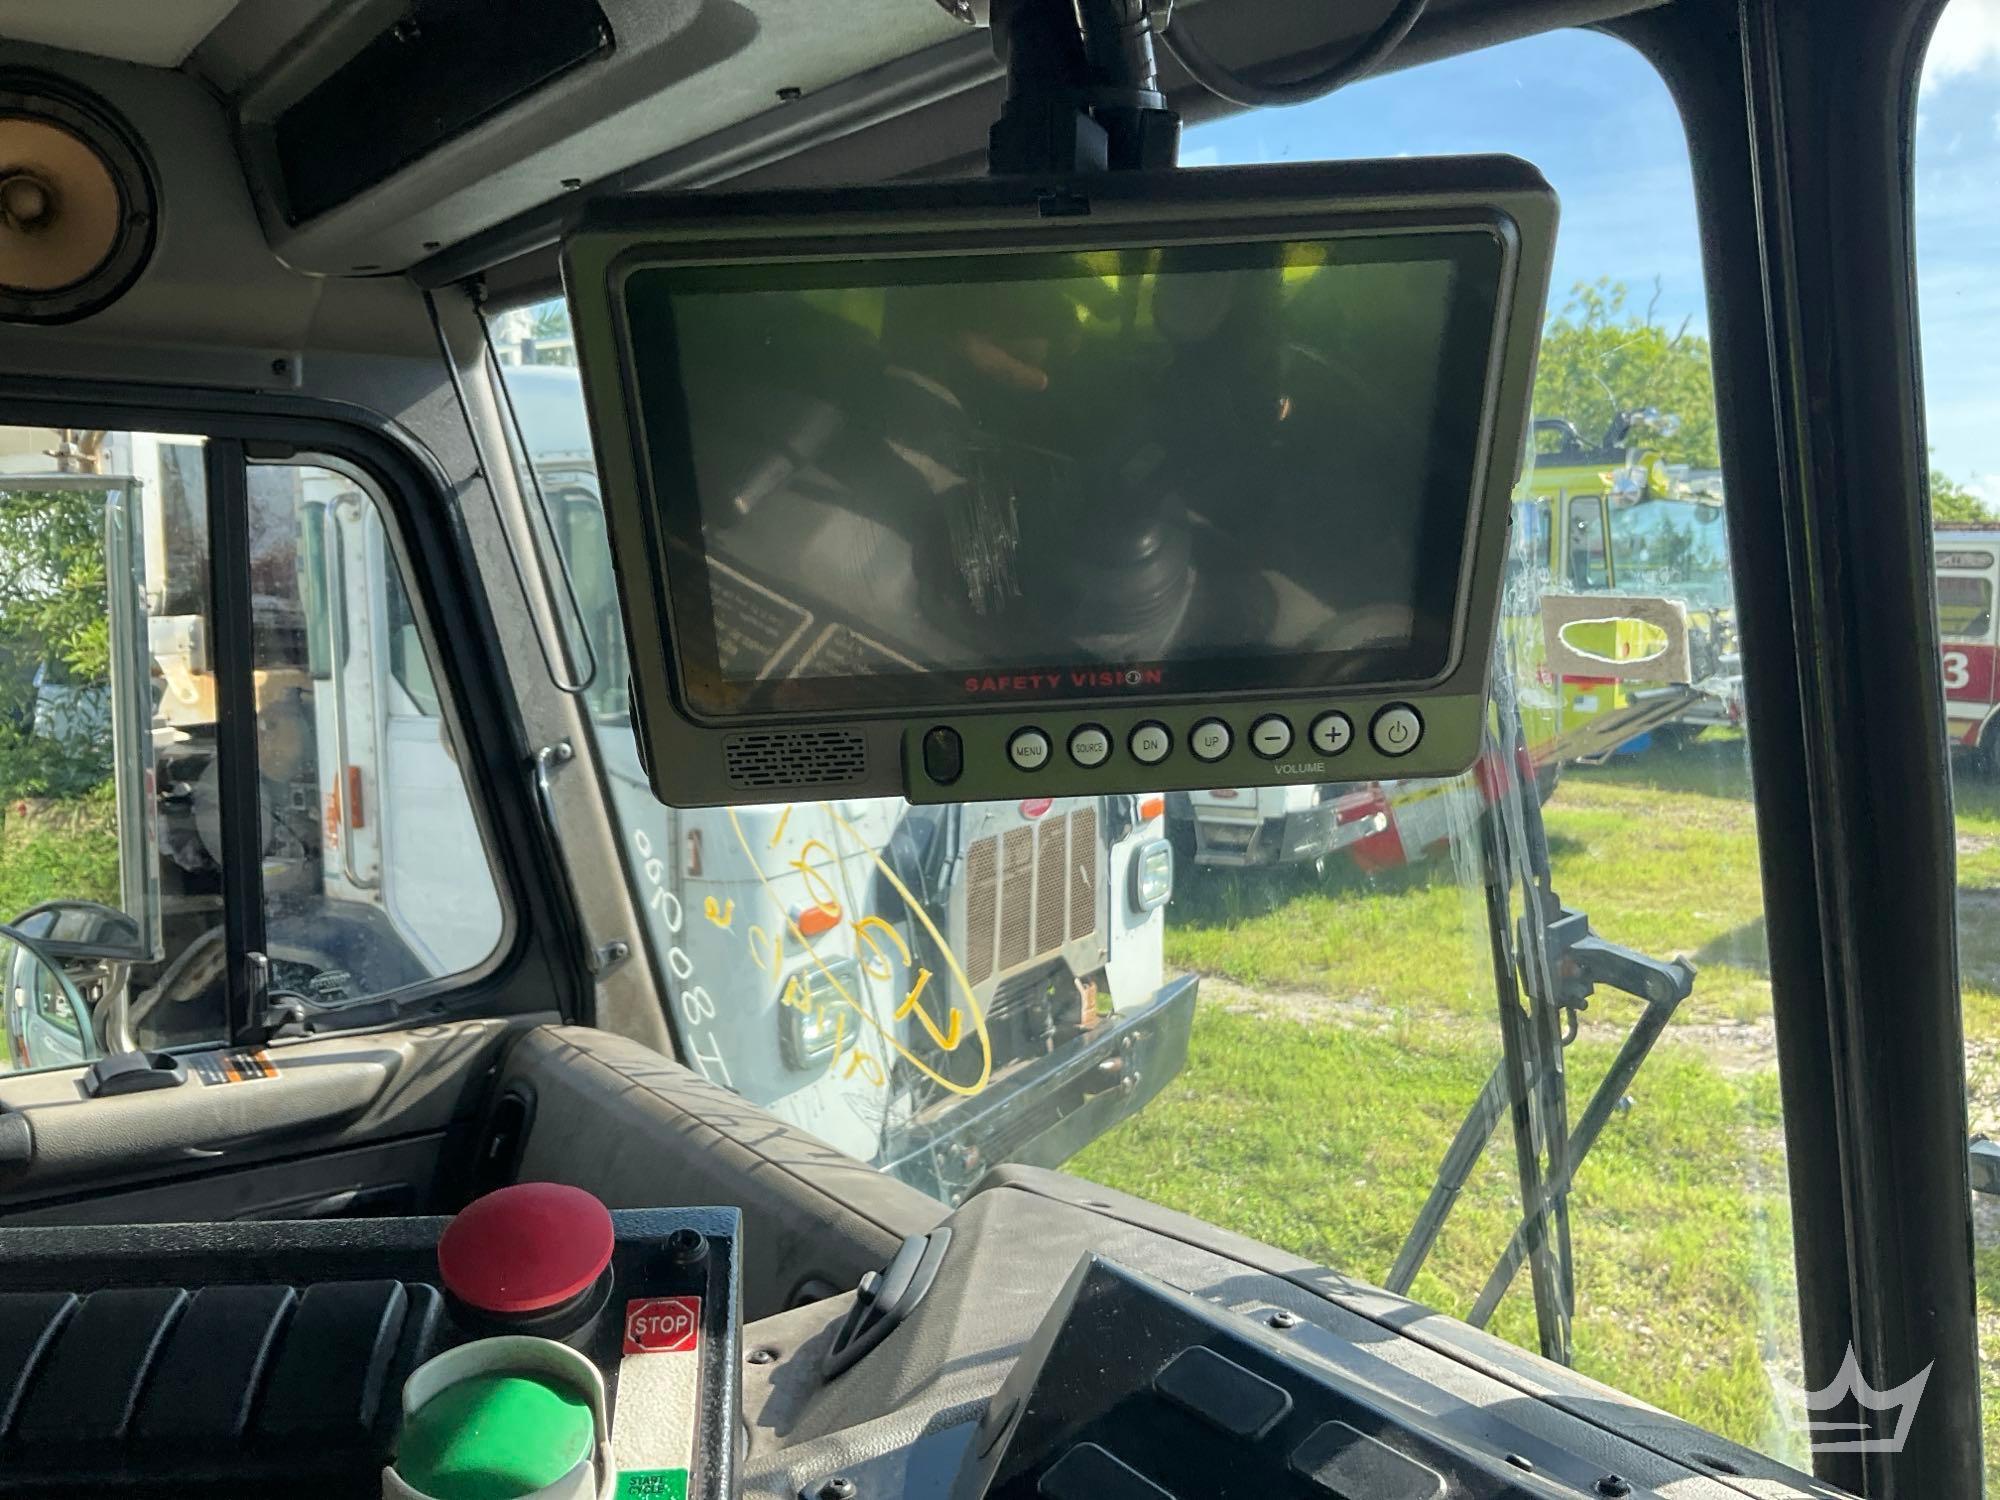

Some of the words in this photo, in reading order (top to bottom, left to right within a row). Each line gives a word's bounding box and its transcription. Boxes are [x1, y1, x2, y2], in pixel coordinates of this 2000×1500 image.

[1942, 652, 1970, 689] 3
[965, 674, 1062, 693] SAFETY
[1071, 669, 1163, 688] VISION
[1142, 738, 1159, 750] DN
[1203, 735, 1220, 748] UP
[1016, 746, 1042, 757] MENU
[1075, 742, 1104, 754] SOURCE
[1274, 762, 1325, 776] VOLUME
[634, 1315, 689, 1335] STOP
[629, 1475, 665, 1486] START
[628, 1485, 665, 1496] CYCLE
